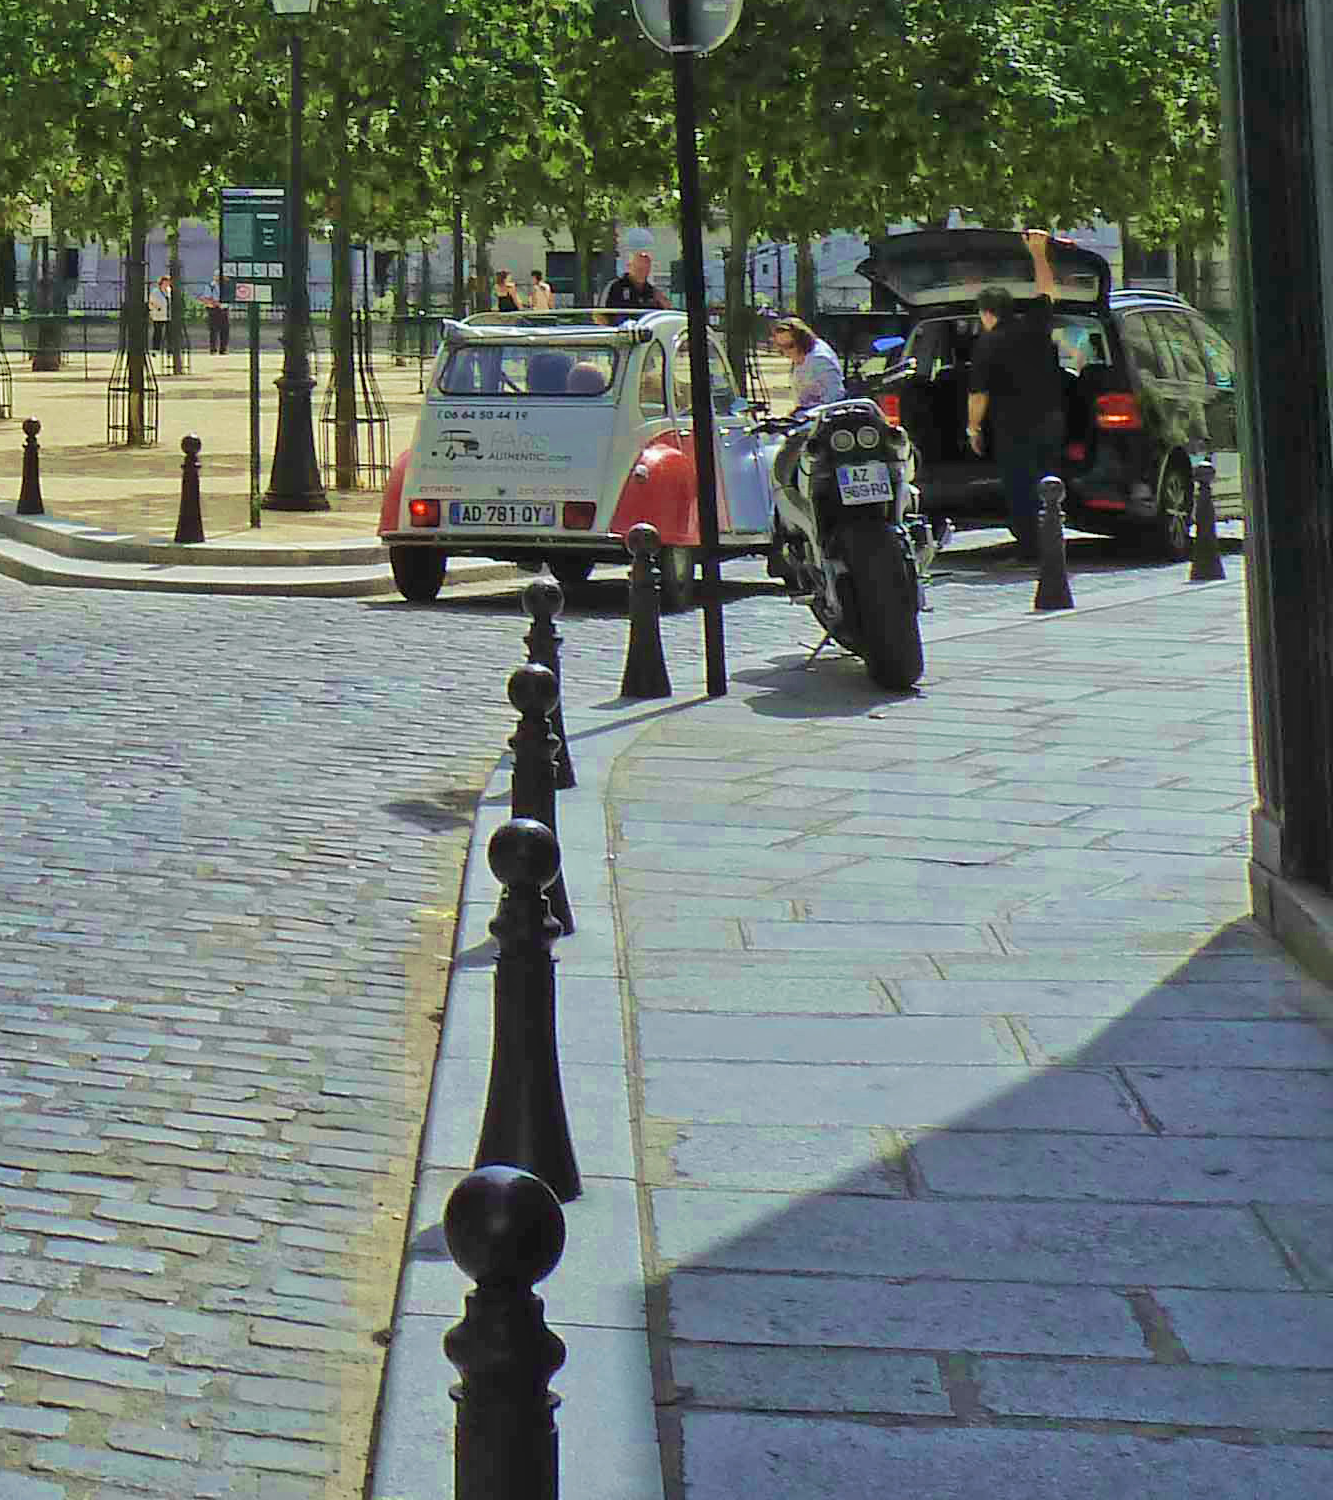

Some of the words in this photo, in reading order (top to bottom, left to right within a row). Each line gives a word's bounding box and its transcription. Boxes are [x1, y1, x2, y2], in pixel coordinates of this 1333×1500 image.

[445, 410, 458, 420] 06
[462, 410, 475, 420] 64
[496, 410, 510, 420] 44
